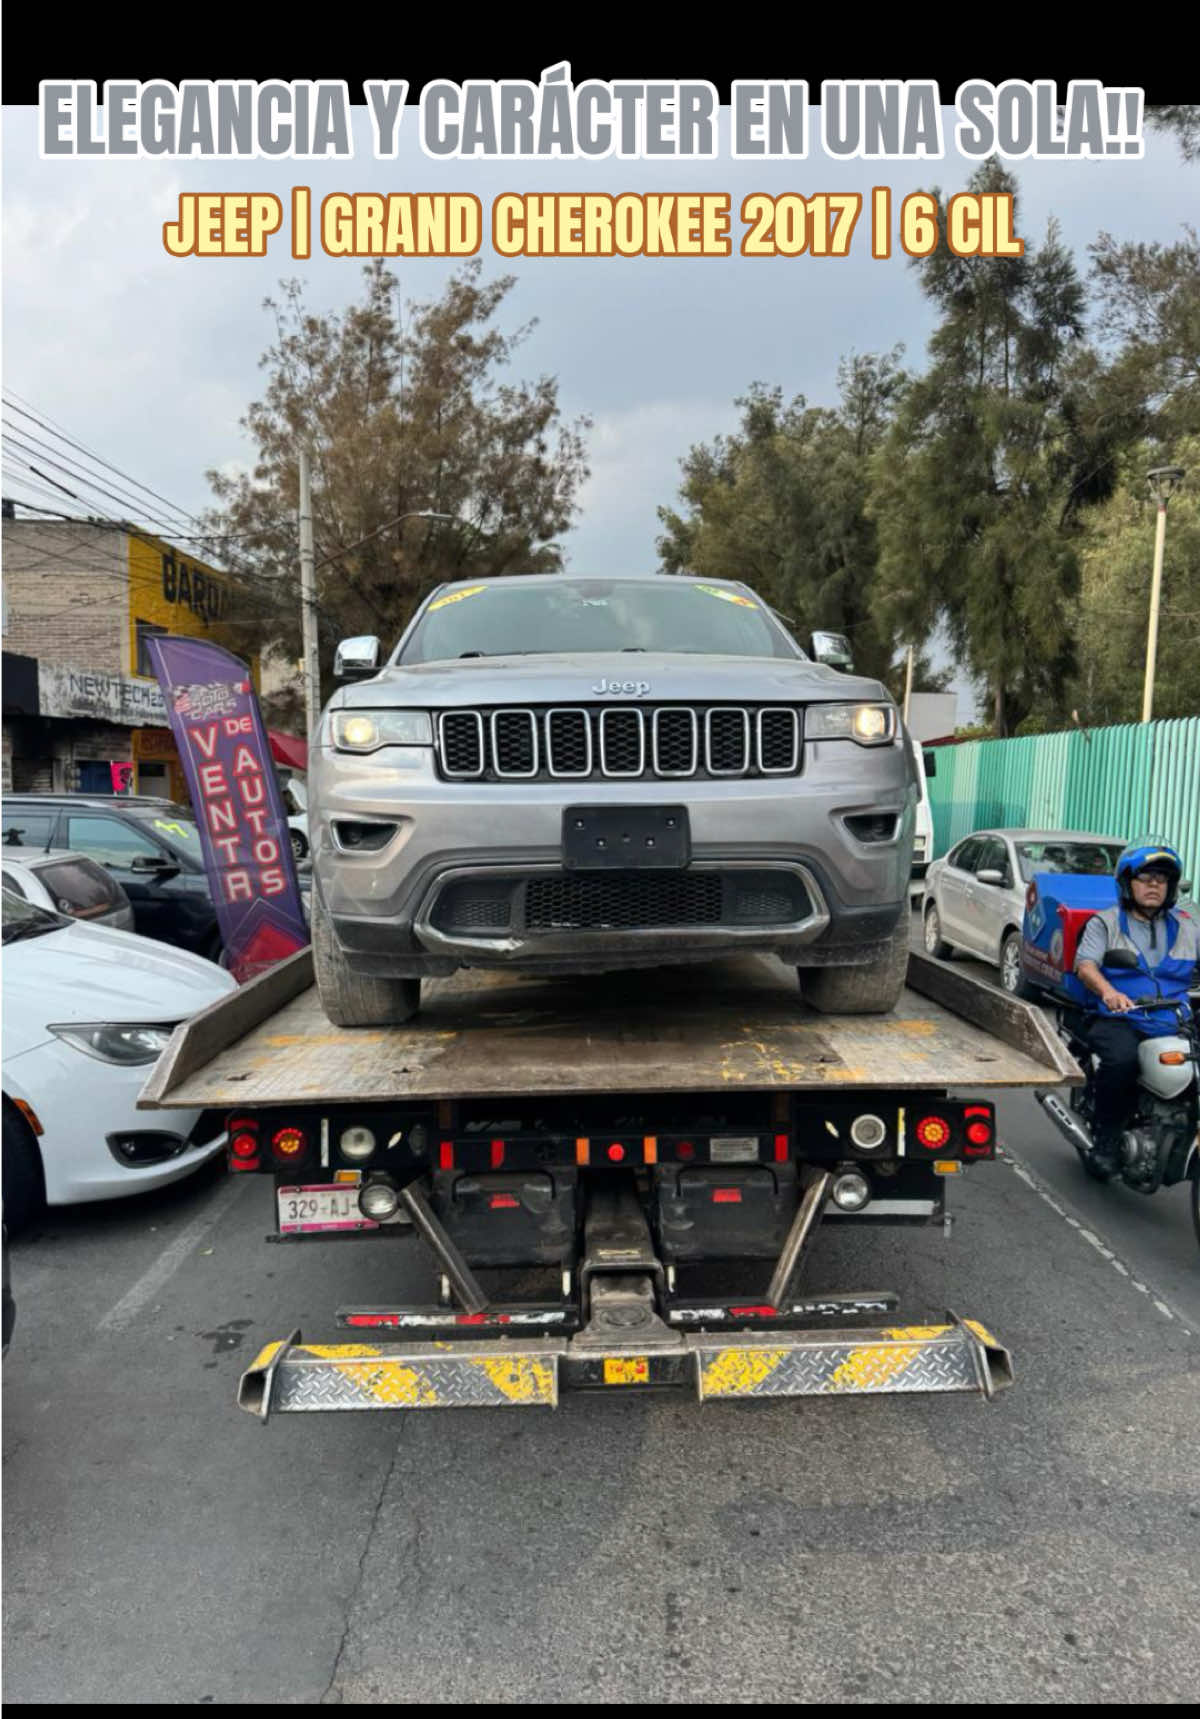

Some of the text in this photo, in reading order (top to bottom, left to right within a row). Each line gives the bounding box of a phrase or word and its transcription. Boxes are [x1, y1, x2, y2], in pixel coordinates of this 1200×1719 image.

[591, 678, 650, 698] Jeep
[224, 717, 253, 735] DE
[191, 724, 253, 901] VENTA
[236, 747, 285, 895] AUTOS
[288, 1197, 360, 1220] 329-AJ-
